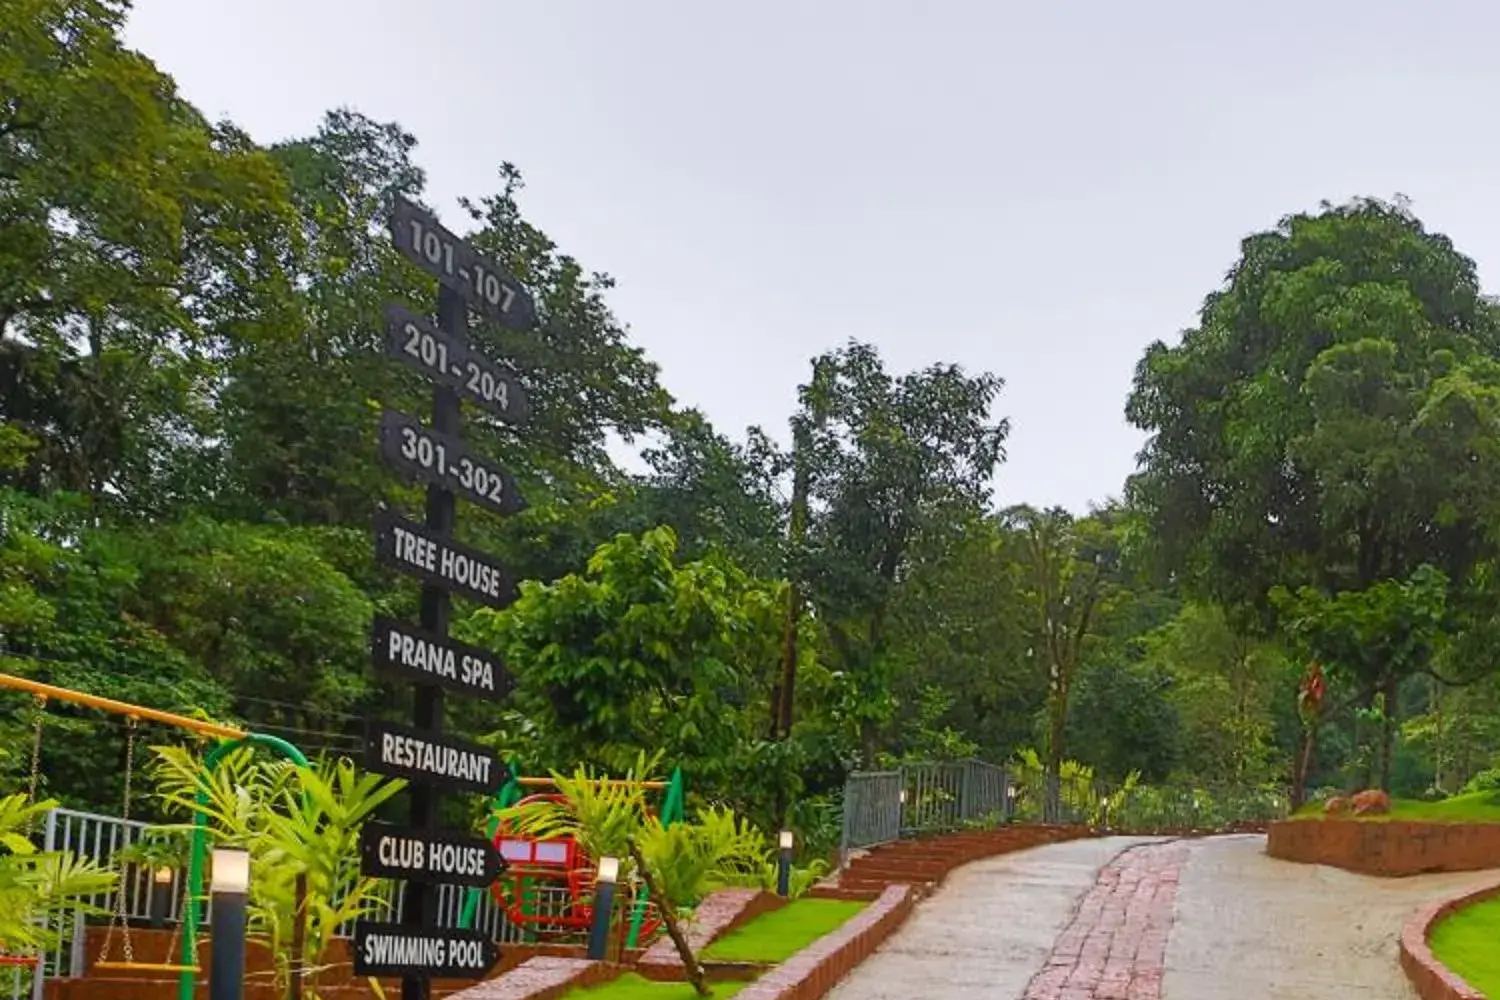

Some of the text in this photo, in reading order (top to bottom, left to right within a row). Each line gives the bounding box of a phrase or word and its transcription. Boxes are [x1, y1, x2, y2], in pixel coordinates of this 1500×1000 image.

[393, 527, 500, 598] TREE HOUSE
[389, 630, 494, 691] PRANA SPA
[382, 732, 491, 784] RESTAURANT
[379, 836, 485, 876] CLUB HOUSE
[364, 933, 485, 968] SWIMMING POOL
